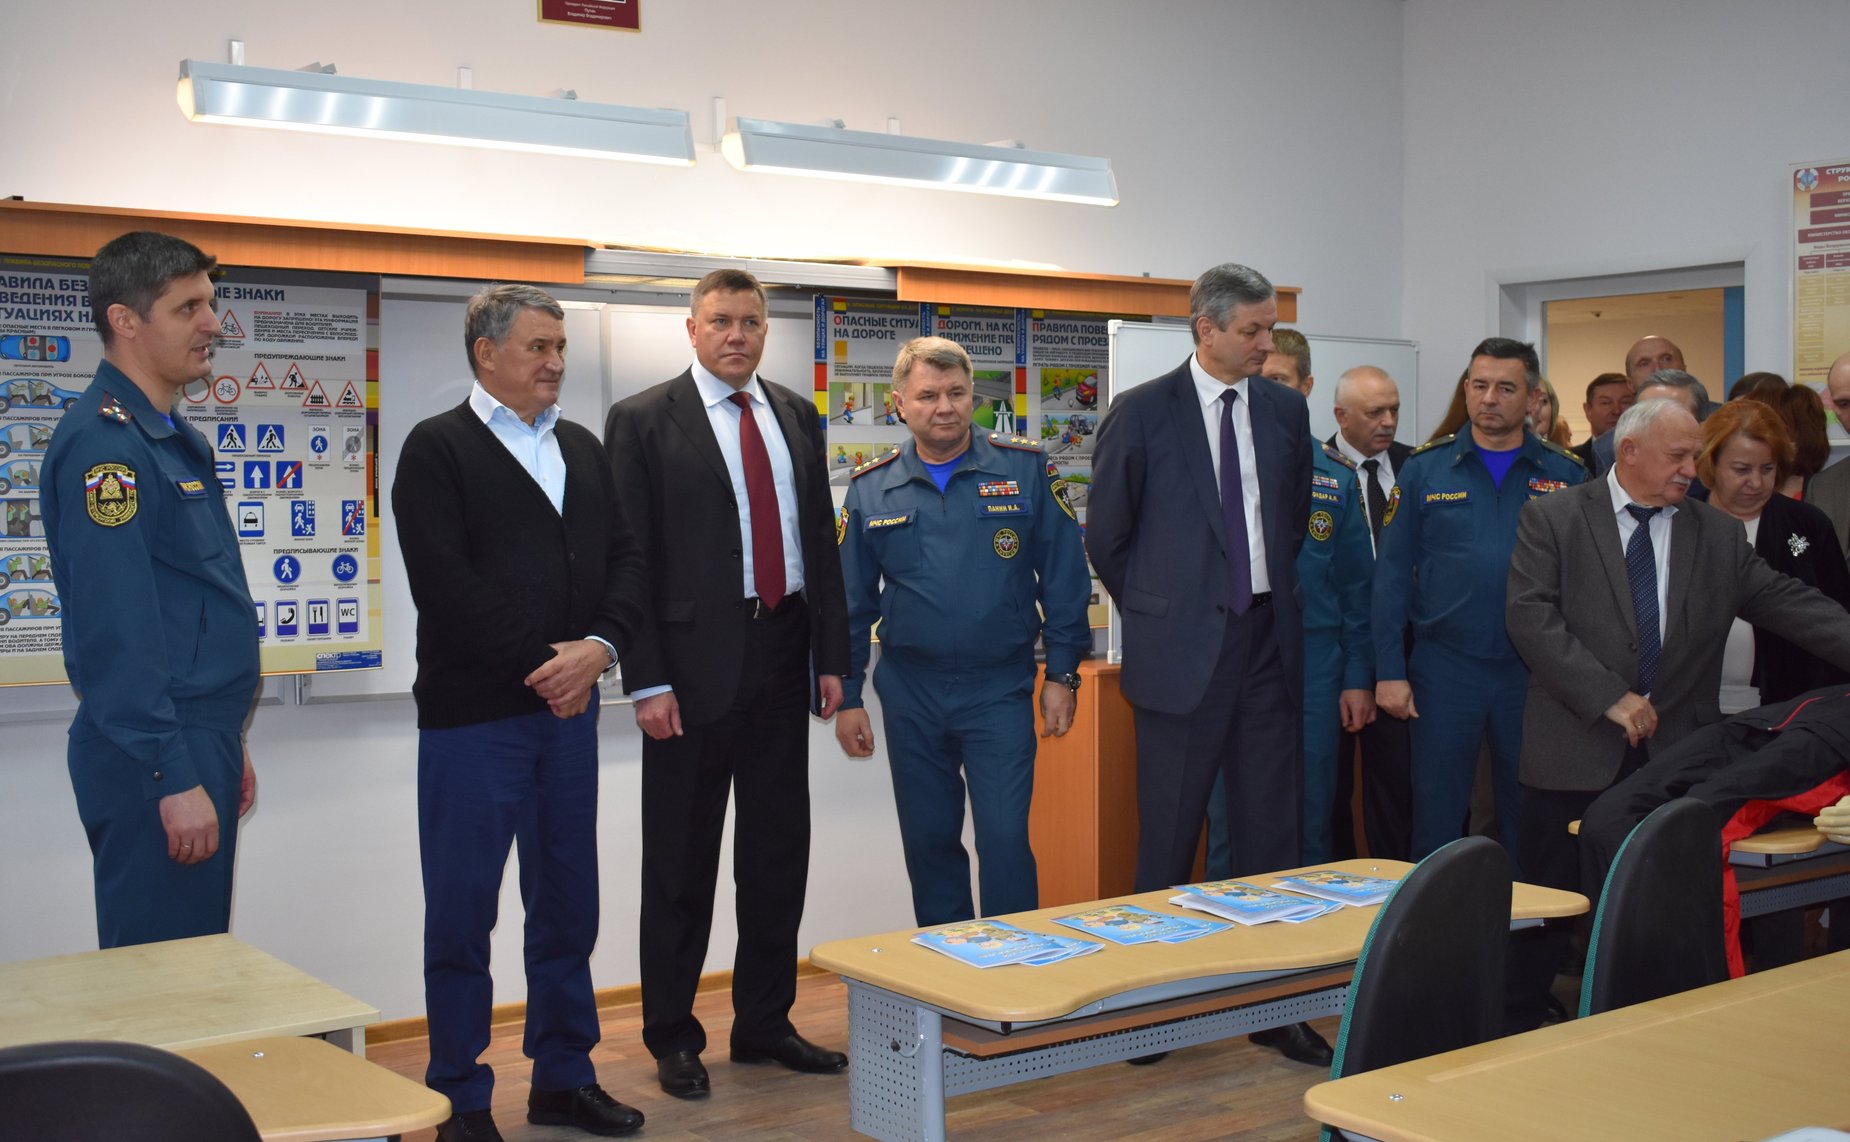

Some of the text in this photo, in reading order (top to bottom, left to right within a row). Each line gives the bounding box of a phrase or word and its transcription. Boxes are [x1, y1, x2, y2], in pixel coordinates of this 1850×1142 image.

[59, 279, 88, 292] БЕЗ
[234, 288, 285, 301] ЗНАКИ
[78, 311, 93, 323] Н
[833, 315, 888, 328] ОПАСНЫЕ
[986, 321, 999, 333] НА
[1032, 322, 1079, 334] ПРАВИЛА
[833, 327, 896, 340] НА ДОРОГЕ
[1032, 334, 1069, 345] РЯДОМ
[1070, 335, 1077, 346] С
[254, 353, 324, 361] ПРЕДУПРЕЖДАЮЩИЕ
[1426, 491, 1467, 502] МЧС РОССИИ
[868, 515, 907, 528] МЧС РОССИИ
[340, 607, 356, 617] WC
